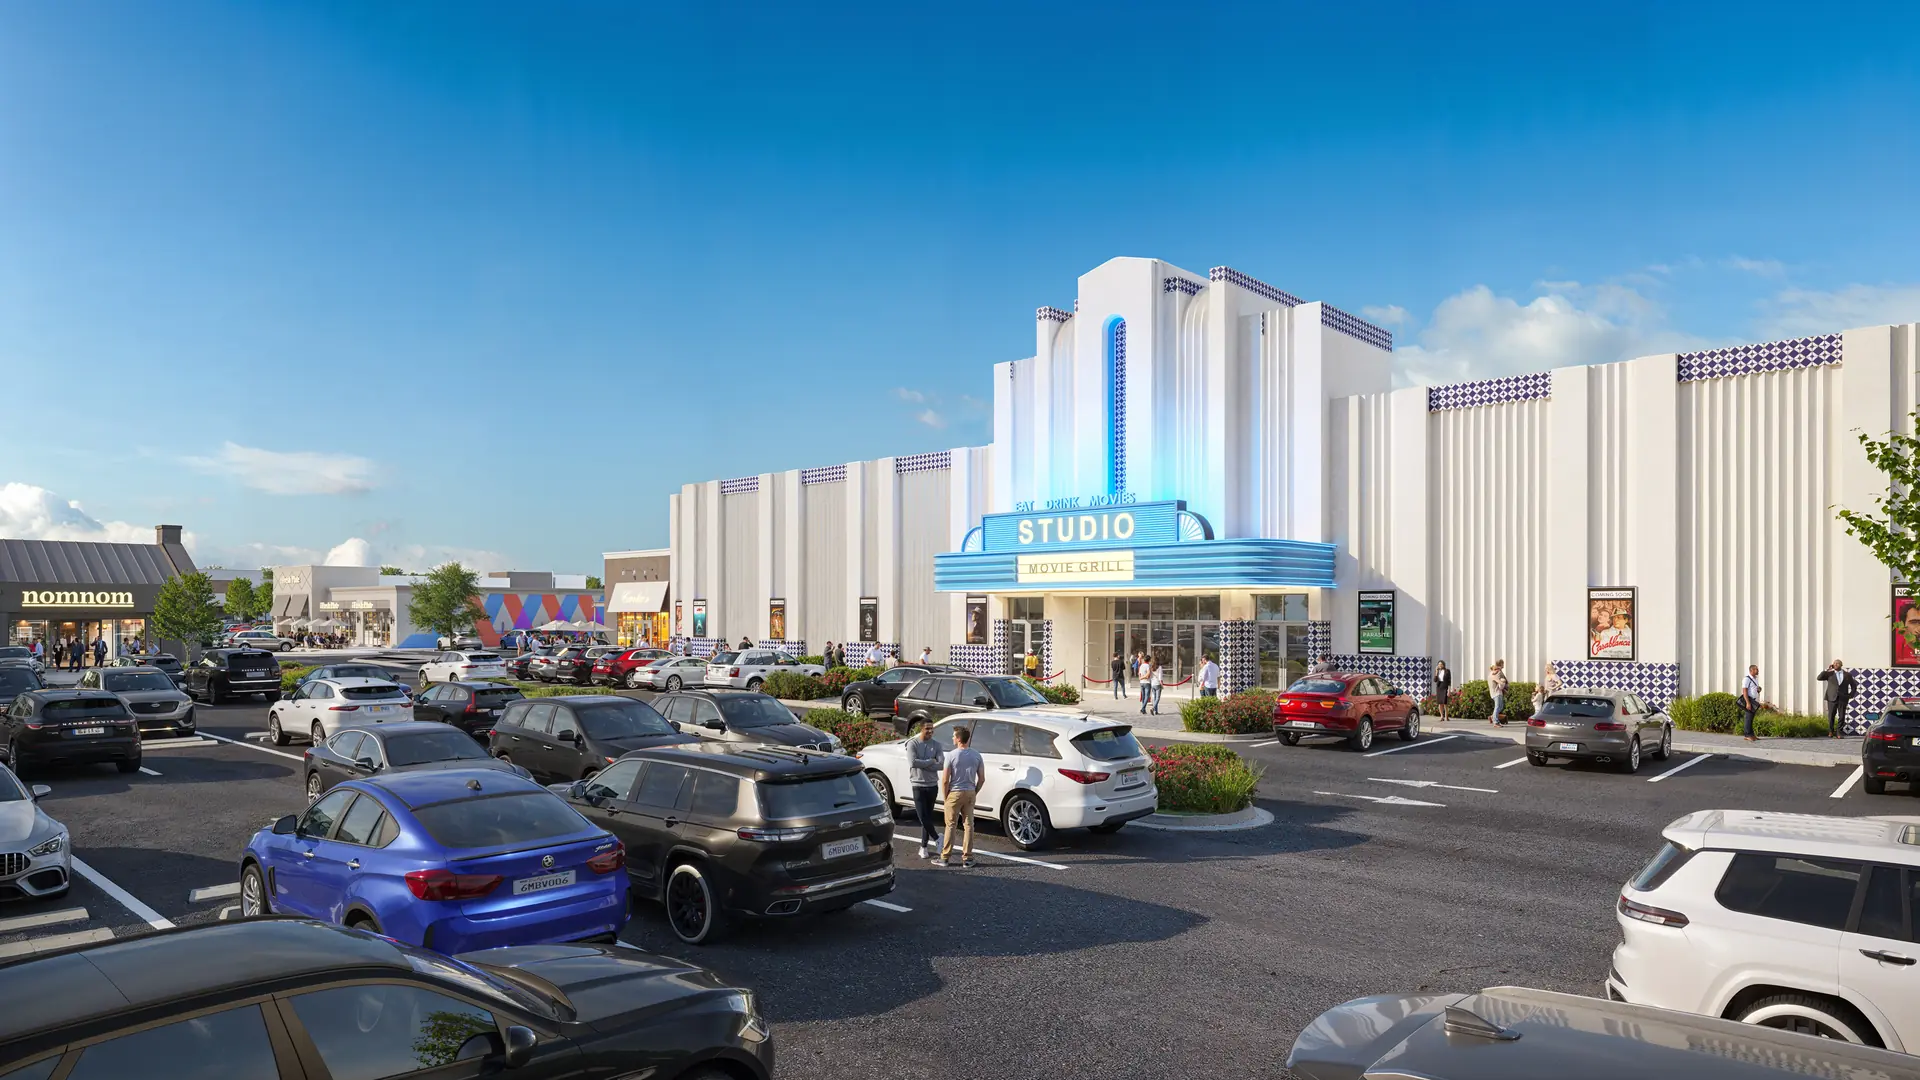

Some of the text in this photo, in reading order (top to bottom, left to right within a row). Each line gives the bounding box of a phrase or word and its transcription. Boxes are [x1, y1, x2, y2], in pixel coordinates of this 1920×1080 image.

[1016, 493, 1136, 512] EAT DRINK MOVIES
[1018, 512, 1135, 545] STUDIO
[1029, 560, 1125, 574] MOVIE GRILL
[22, 590, 135, 605] nomnom
[827, 842, 860, 856] 6MBV006
[520, 876, 569, 893] 6MBV006
